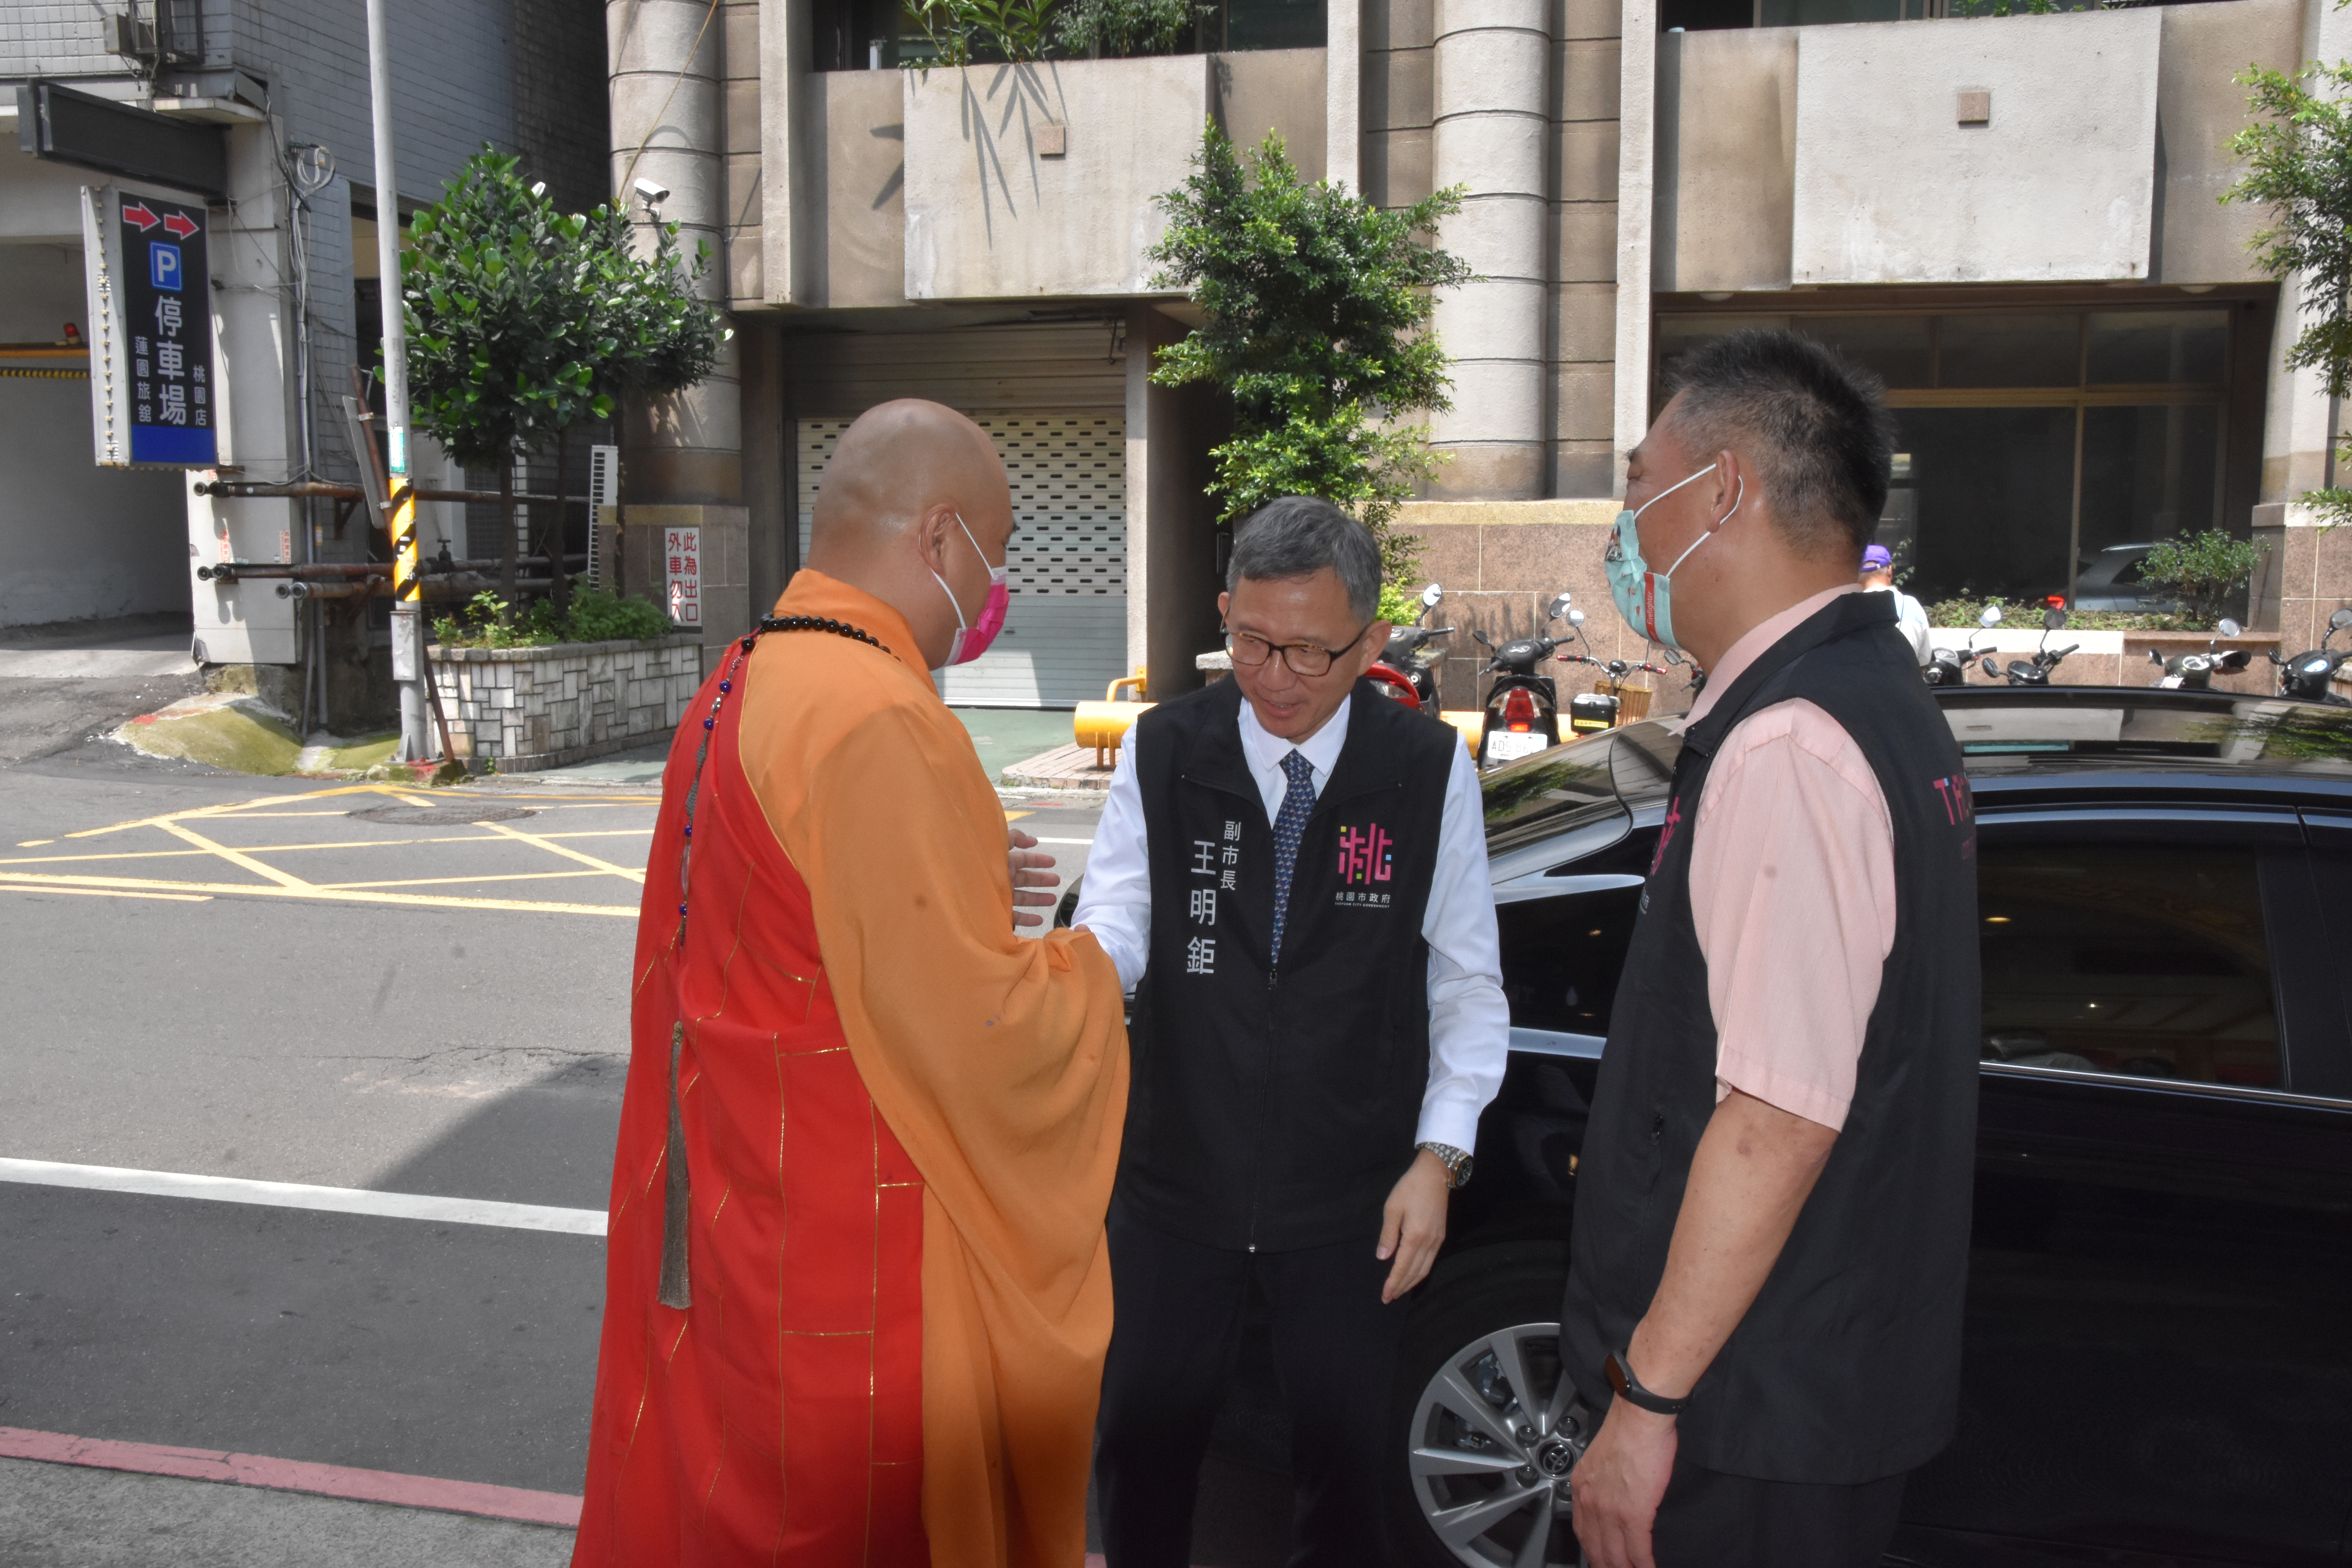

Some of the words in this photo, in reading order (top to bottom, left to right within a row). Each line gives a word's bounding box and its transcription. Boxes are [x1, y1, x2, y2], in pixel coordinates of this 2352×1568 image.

[157, 250, 176, 282] P
[155, 295, 187, 425] 停車場
[193, 364, 207, 426] 桃園店
[668, 532, 684, 622] 外車勿入
[684, 532, 698, 621] 此為出口
[1220, 821, 1241, 891] 副市長
[1187, 840, 1216, 974] 王明鉅
[1336, 892, 1390, 903] 桃園市政府
